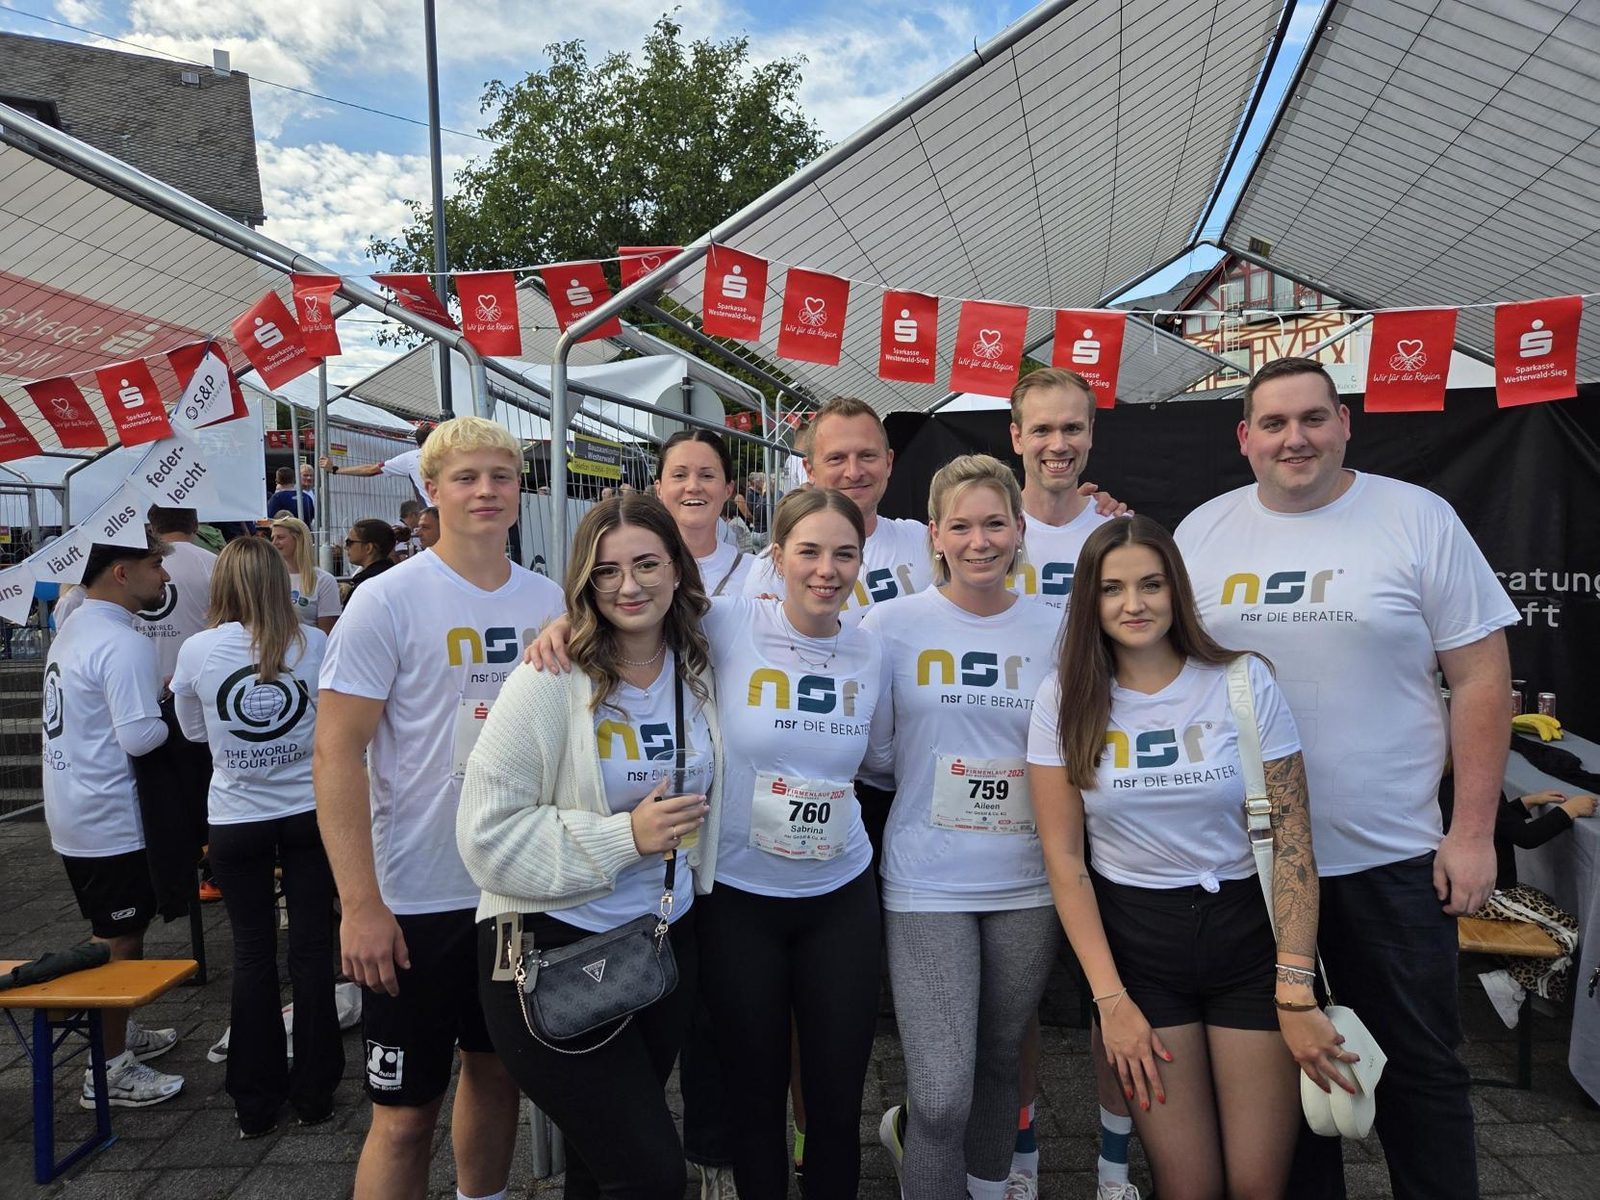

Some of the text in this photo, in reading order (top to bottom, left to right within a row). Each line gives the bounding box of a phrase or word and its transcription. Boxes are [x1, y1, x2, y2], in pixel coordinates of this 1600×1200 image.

[717, 302, 747, 313] Sparkasse
[708, 309, 756, 323] Westerwald-Sieg
[477, 323, 485, 332] für
[495, 322, 514, 332] Region
[785, 324, 838, 340] Wir für die Region
[267, 344, 295, 362] Sparkasse
[893, 347, 919, 356] Sparkasse
[885, 354, 929, 365] Westerwald-Sieg
[958, 358, 1014, 372] Wir für die Region
[1516, 362, 1555, 374] Sparkasse
[1373, 372, 1440, 384] Wir für die Region
[1504, 370, 1568, 384] Westerwald-Sieg
[194, 375, 215, 409] S&P
[121, 415, 162, 430] Westerwald-Sieg
[126, 411, 152, 421] Sparkasse
[145, 447, 184, 488] feder-
[167, 461, 206, 504] leicht
[104, 505, 136, 538] alles
[47, 545, 84, 574] läuft
[1005, 562, 1075, 595] ns
[1241, 610, 1357, 623] nsr DIE BERATER.
[471, 672, 489, 683] nsr
[941, 694, 1034, 710] nsr DIE BERATE
[775, 719, 870, 736] nsr DIE BERATE
[225, 743, 297, 758] THE WORLD
[227, 759, 236, 768] IS
[239, 759, 267, 769] OUR
[627, 771, 648, 781] nsr
[1113, 778, 1138, 789] nsr
[1144, 776, 1168, 788] DIE
[968, 779, 1009, 800] 759
[788, 800, 831, 824] 760
[973, 802, 1000, 810] Aileen
[791, 825, 824, 834] Sabrina
